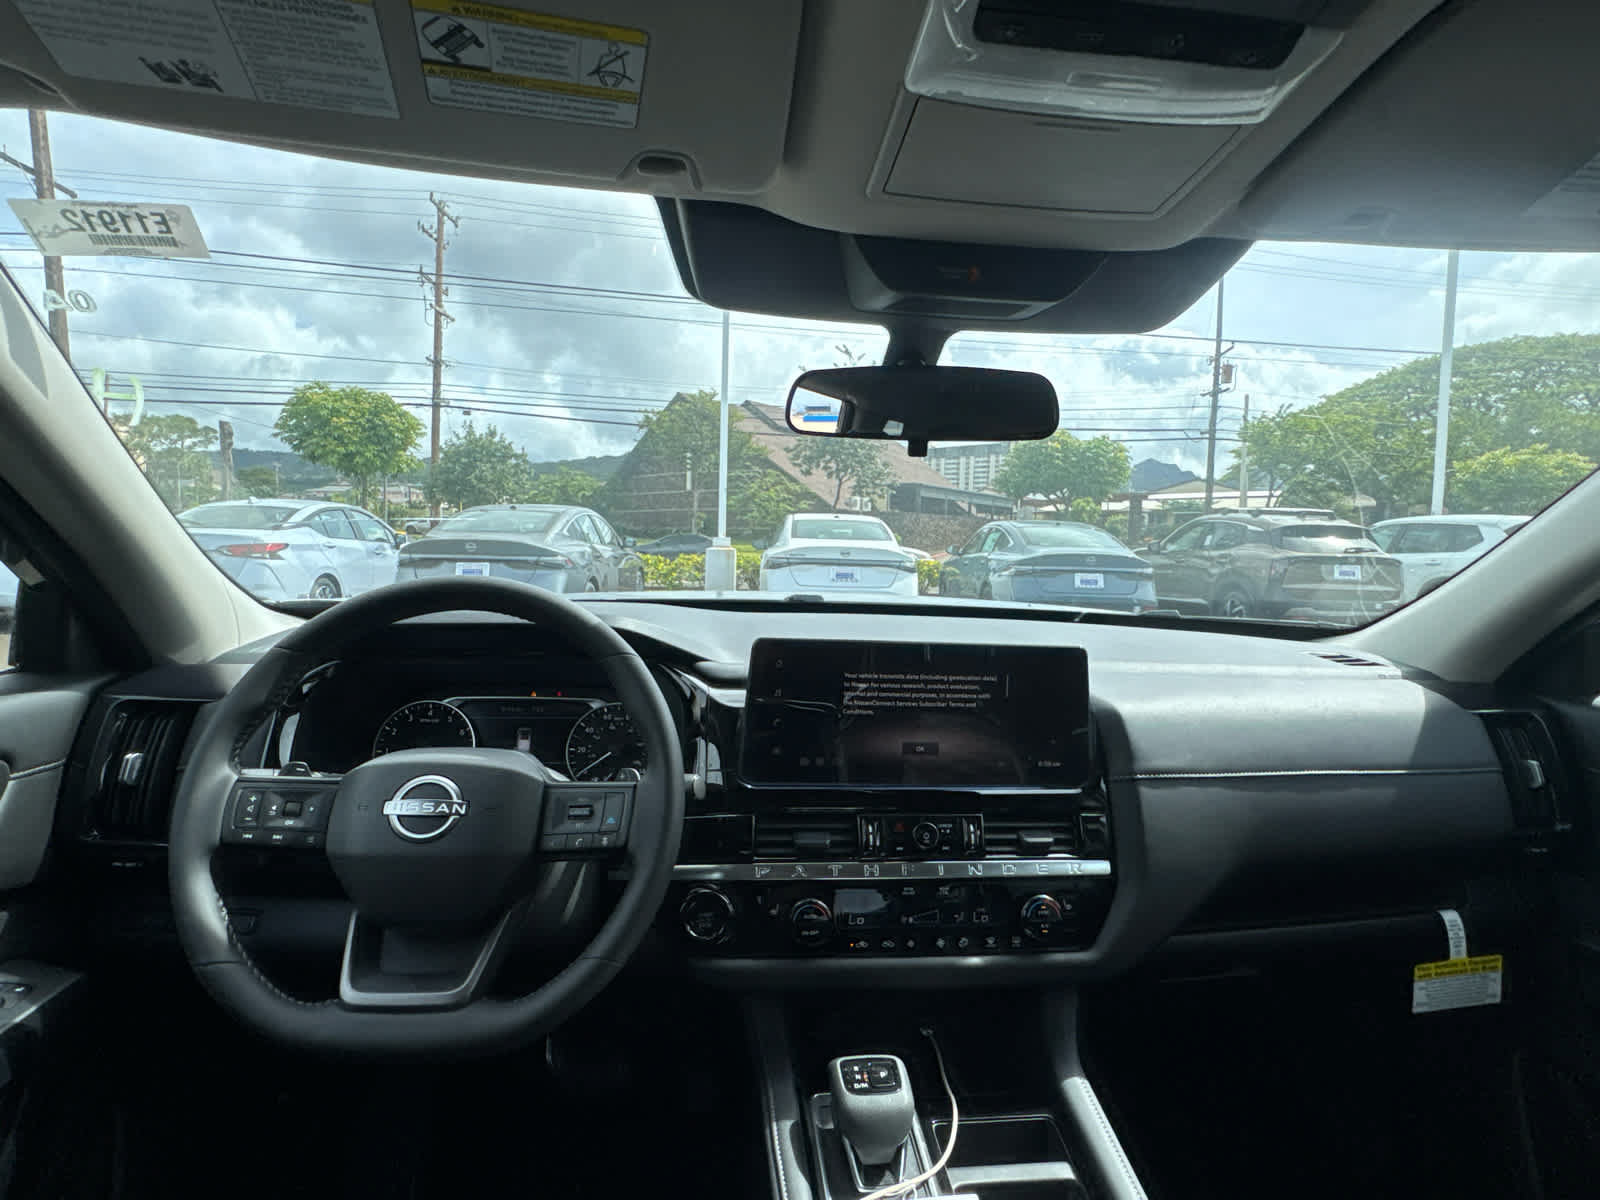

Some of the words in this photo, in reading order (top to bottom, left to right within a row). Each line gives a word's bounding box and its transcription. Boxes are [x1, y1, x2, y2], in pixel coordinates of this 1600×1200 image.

[384, 801, 468, 815] NISSAN
[754, 863, 1084, 879] PATHFINDER
[848, 913, 865, 925] Lo
